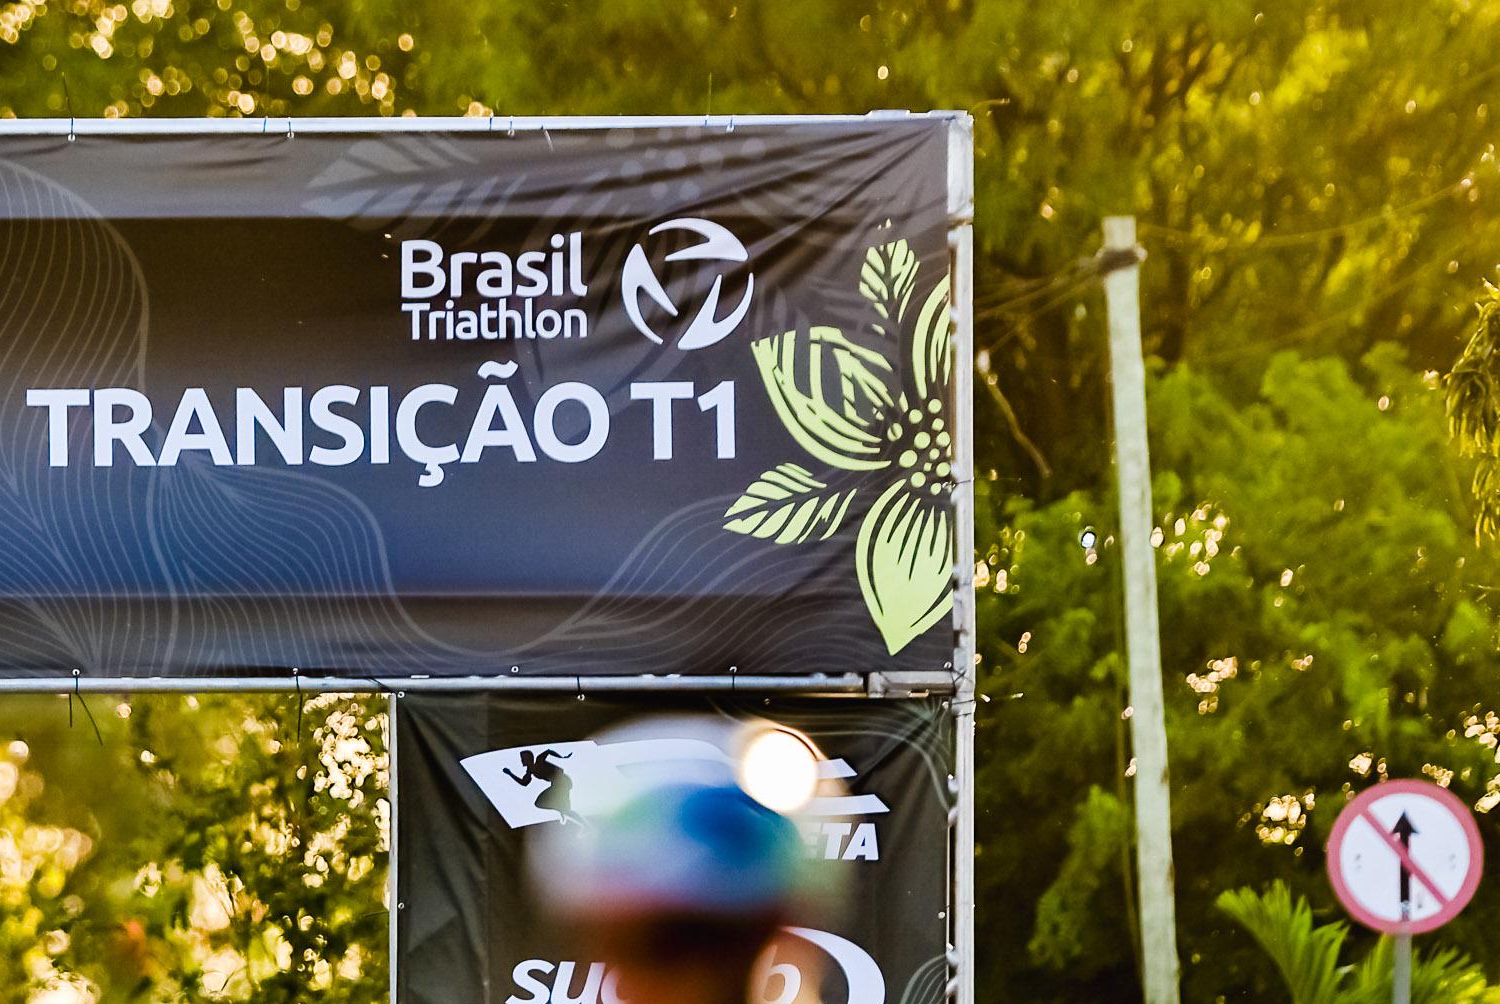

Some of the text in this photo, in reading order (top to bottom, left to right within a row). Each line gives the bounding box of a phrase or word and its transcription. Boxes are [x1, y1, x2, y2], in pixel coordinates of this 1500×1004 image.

[400, 231, 588, 299] Brasil
[400, 300, 589, 341] Triathlon
[26, 360, 736, 488] TRANSIÇÃO T1
